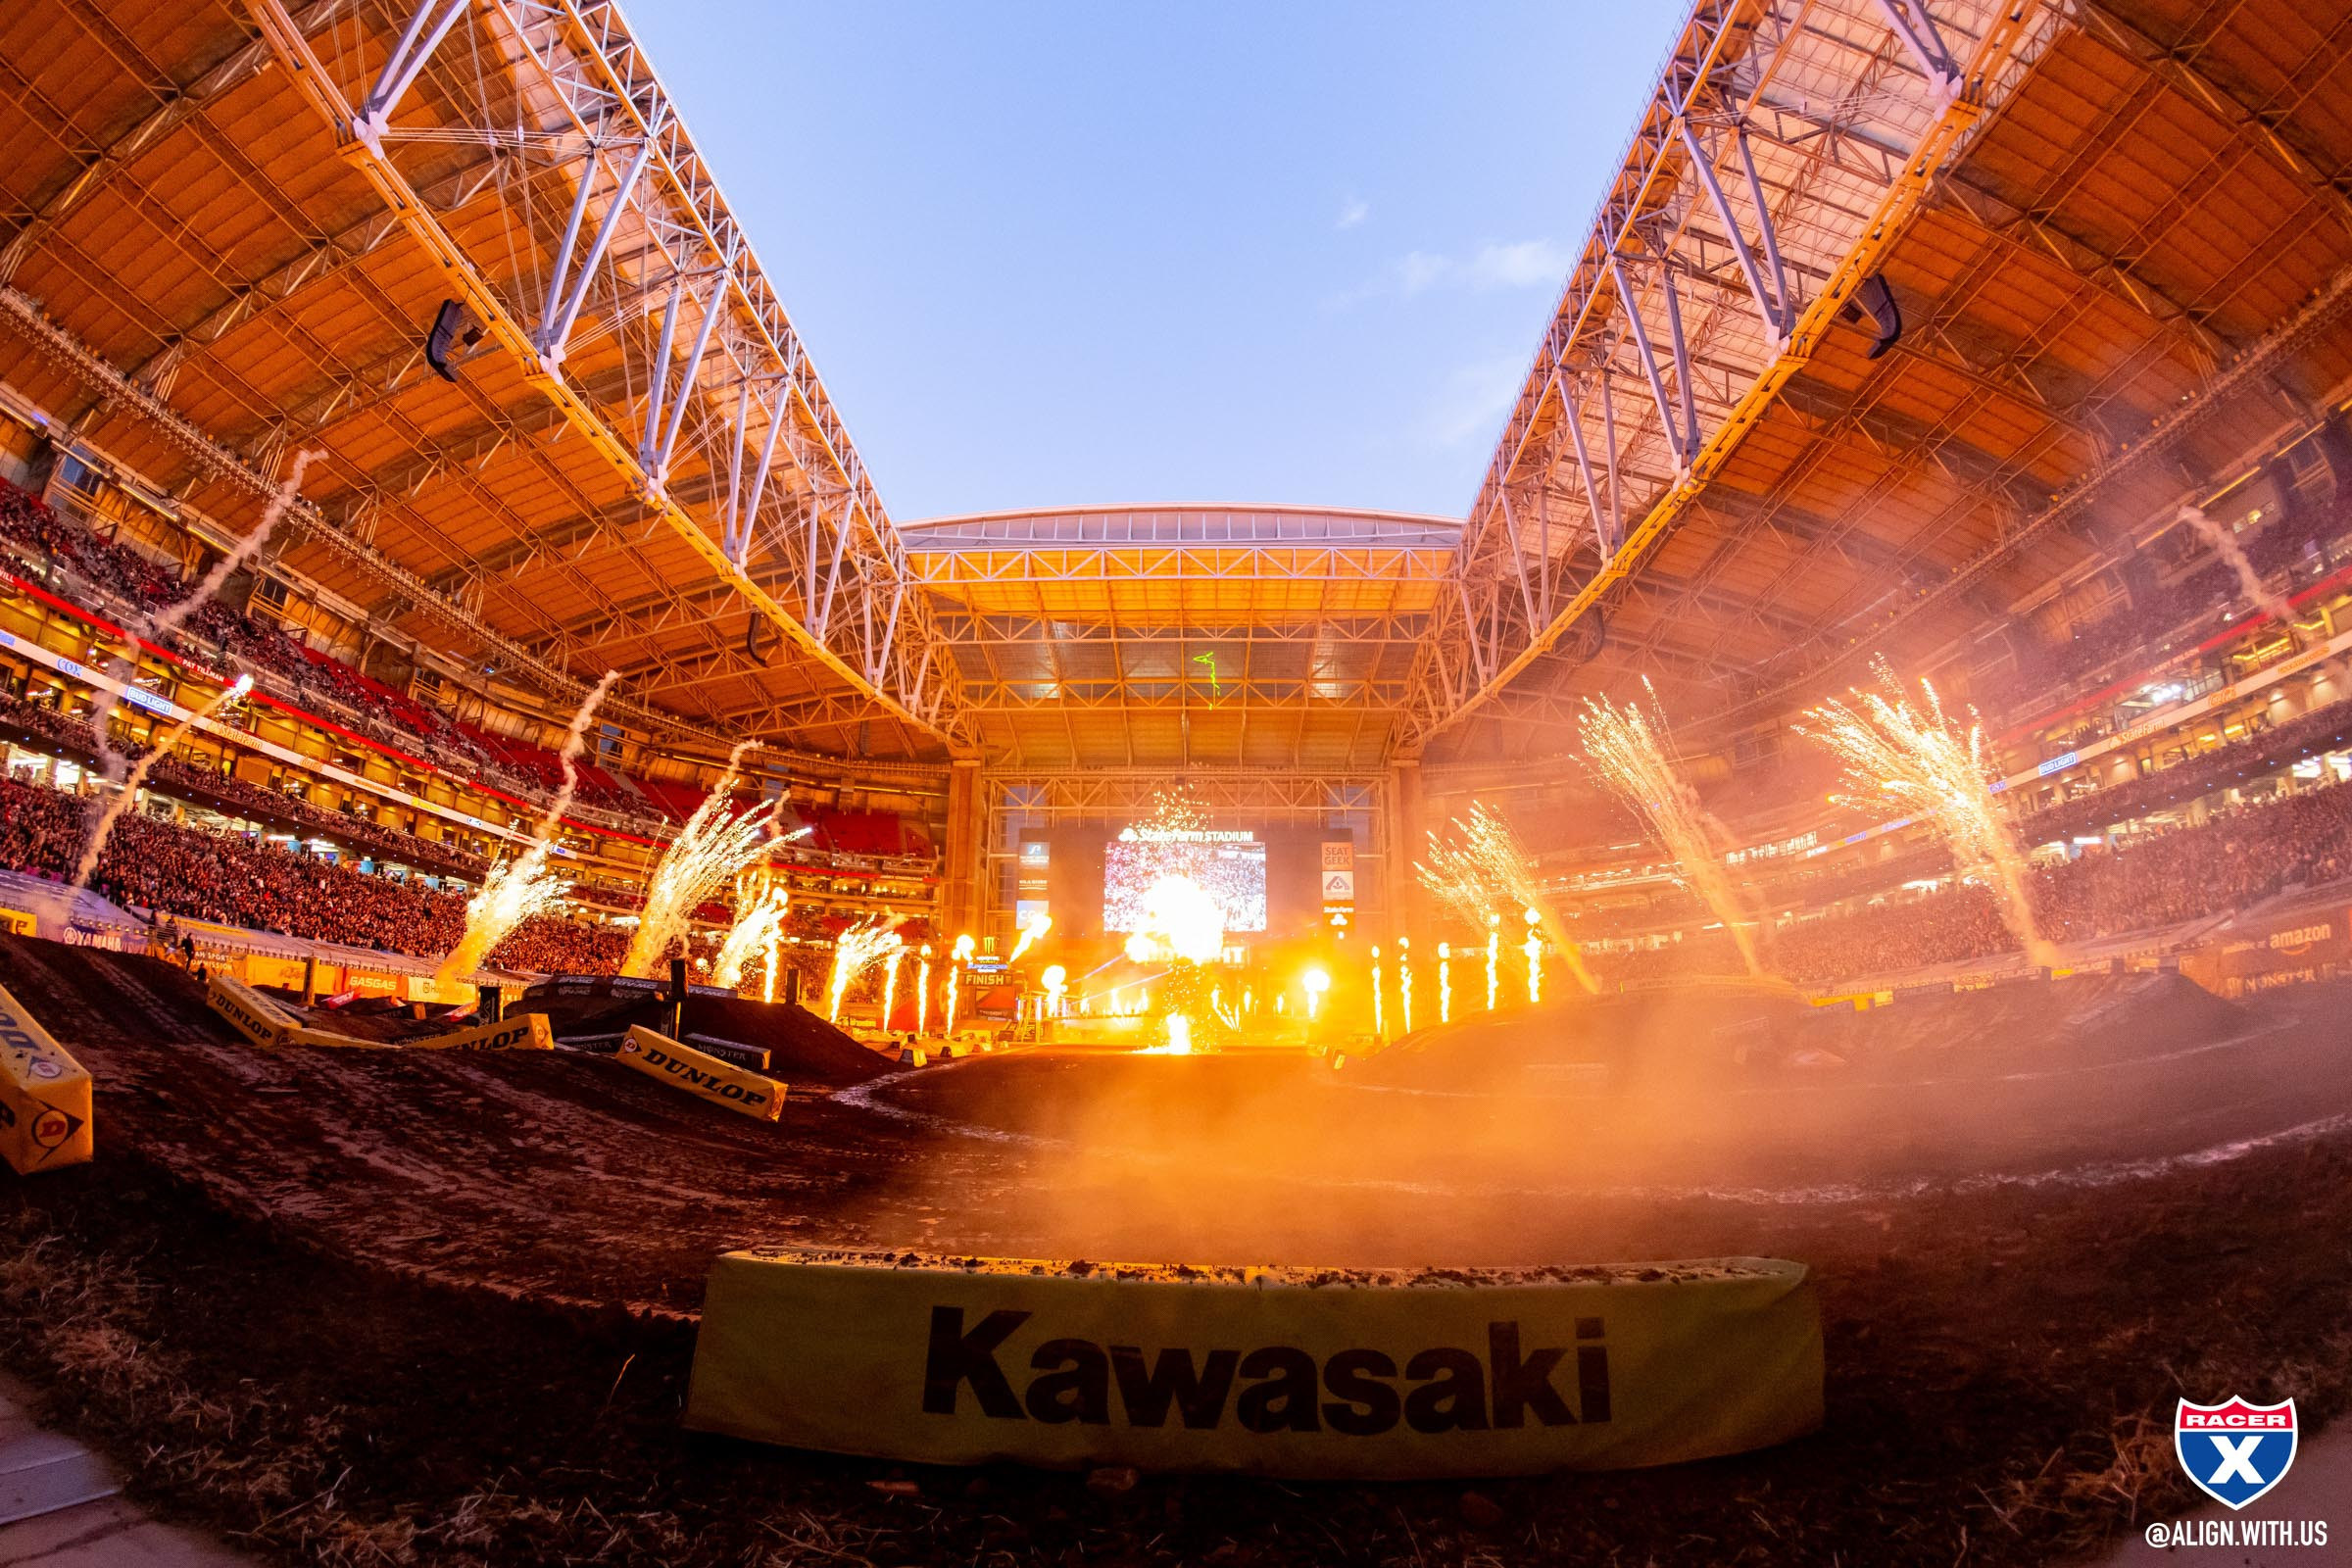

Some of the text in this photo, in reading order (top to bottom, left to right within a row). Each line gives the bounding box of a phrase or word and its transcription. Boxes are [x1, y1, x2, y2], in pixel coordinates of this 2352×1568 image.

[182, 659, 196, 670] PAT
[197, 664, 224, 682] TILLMAN
[147, 695, 172, 713] LIGHT
[1204, 831, 1253, 842] STADIUM
[1325, 847, 1348, 856] SEAT
[77, 929, 122, 953] YAMAHA
[2270, 924, 2331, 950] amazon
[192, 959, 233, 970] OMMISSION
[208, 952, 233, 962] SPORTS
[349, 975, 397, 991] GASGAS
[965, 974, 1004, 985] FINISH
[216, 994, 272, 1040] DUNLOP
[642, 1048, 767, 1106] DUNLOP
[921, 1304, 1612, 1438] Kawasaki
